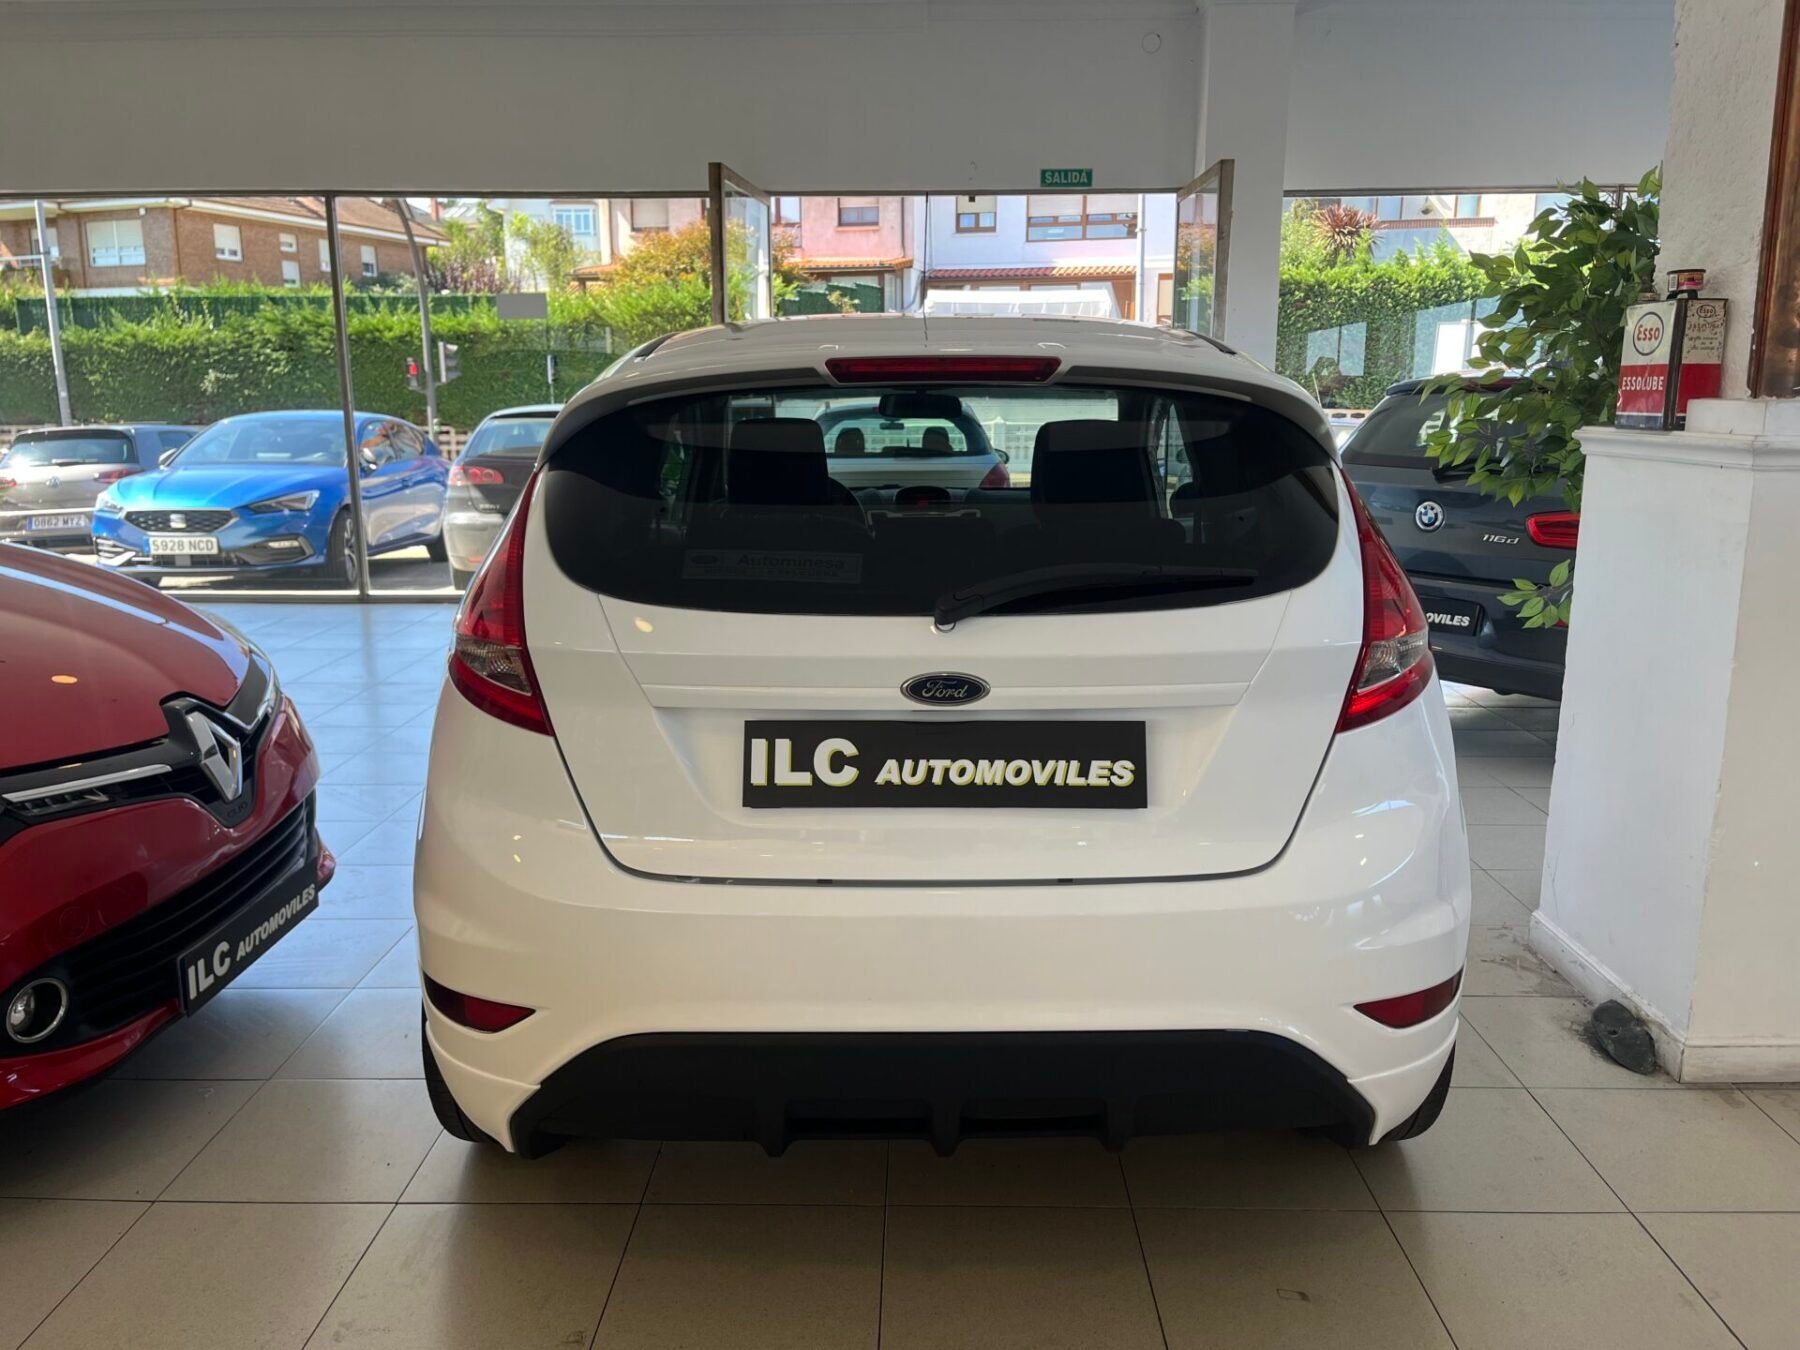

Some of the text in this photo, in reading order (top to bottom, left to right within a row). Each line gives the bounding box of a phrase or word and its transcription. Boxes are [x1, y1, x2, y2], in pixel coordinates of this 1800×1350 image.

[1044, 171, 1089, 184] SALIDA
[1621, 376, 1664, 391] ESSOLUBE
[152, 538, 214, 552] 5928 NCD
[1482, 533, 1520, 545] 116d
[736, 554, 846, 570] Autominesa
[1426, 612, 1471, 627] OVILES
[921, 679, 969, 699] Ford
[750, 737, 1136, 787] ILC AUTOMOVILES
[187, 883, 316, 1000] ILC AUTOMOVILES
